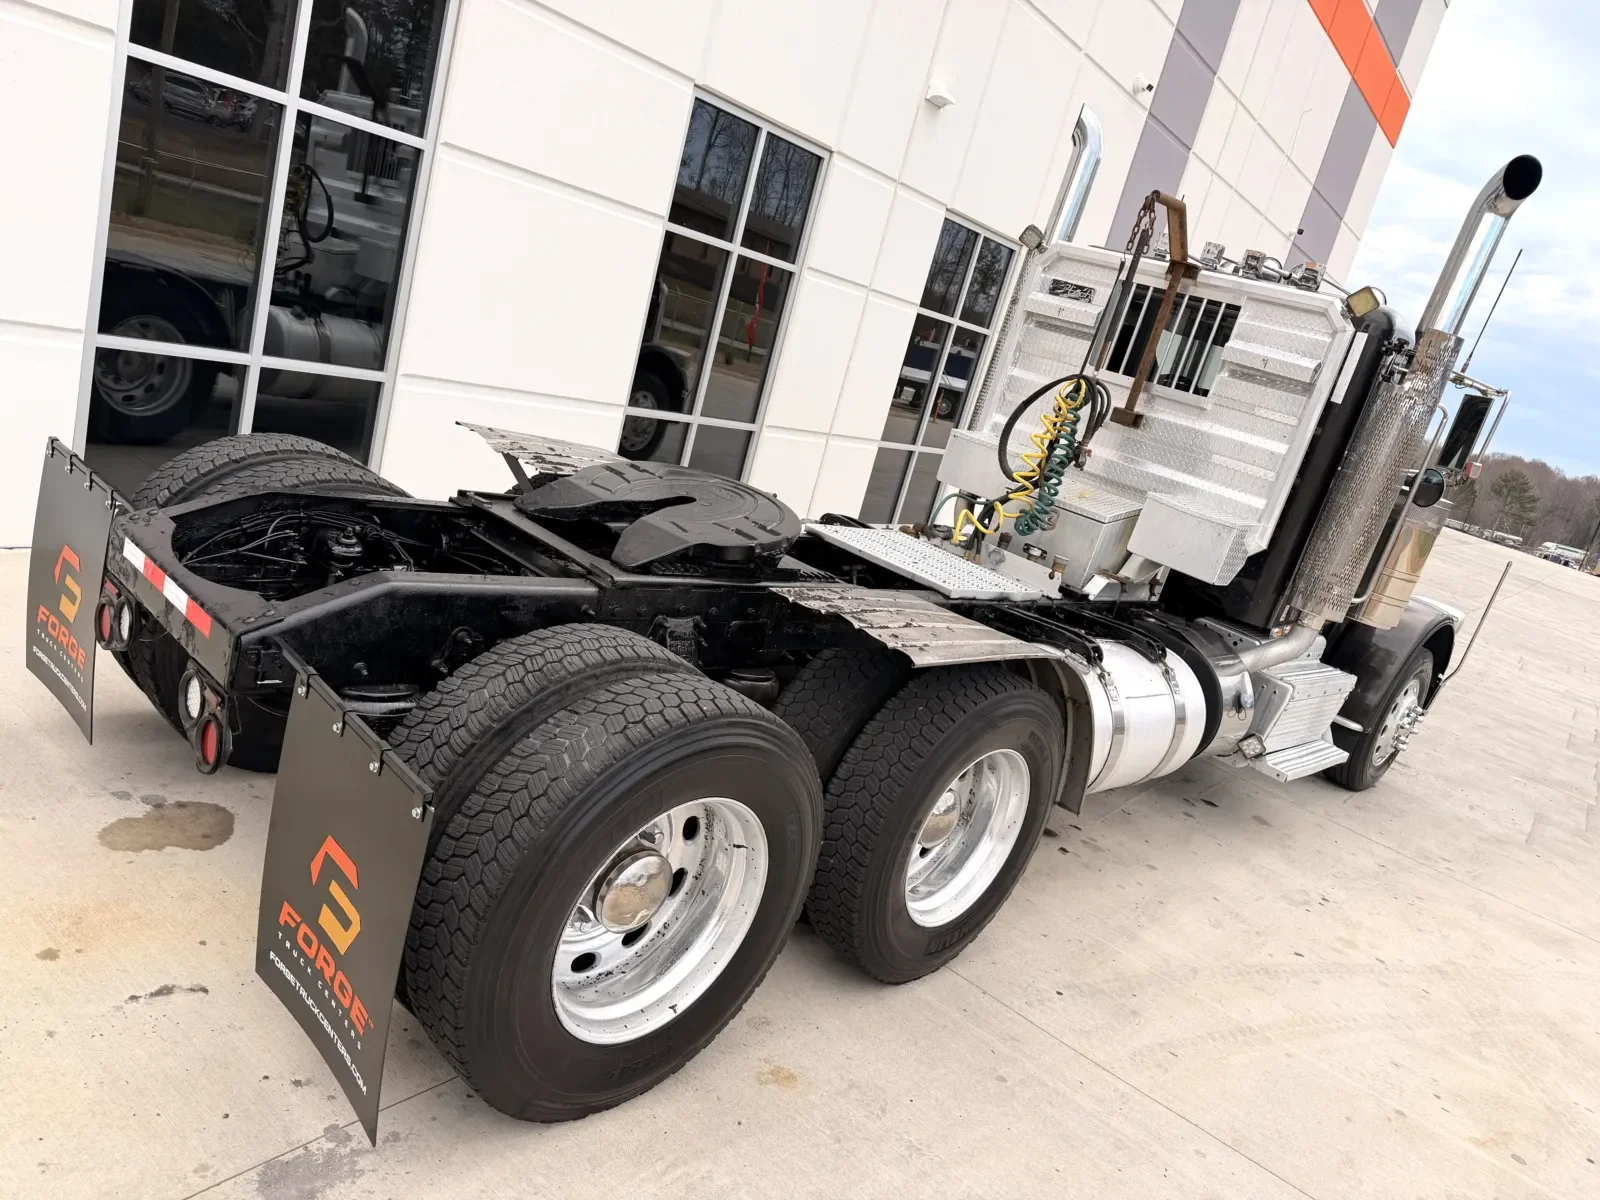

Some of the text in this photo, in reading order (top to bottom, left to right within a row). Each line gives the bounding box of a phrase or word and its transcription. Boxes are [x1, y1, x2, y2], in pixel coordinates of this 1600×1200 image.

[37, 604, 88, 672] FORGE
[269, 950, 367, 1096] FORGETRUCKCENTERS.COM
[277, 931, 362, 1050] TRUCK CENTERS
[278, 900, 369, 1036] FORGE
